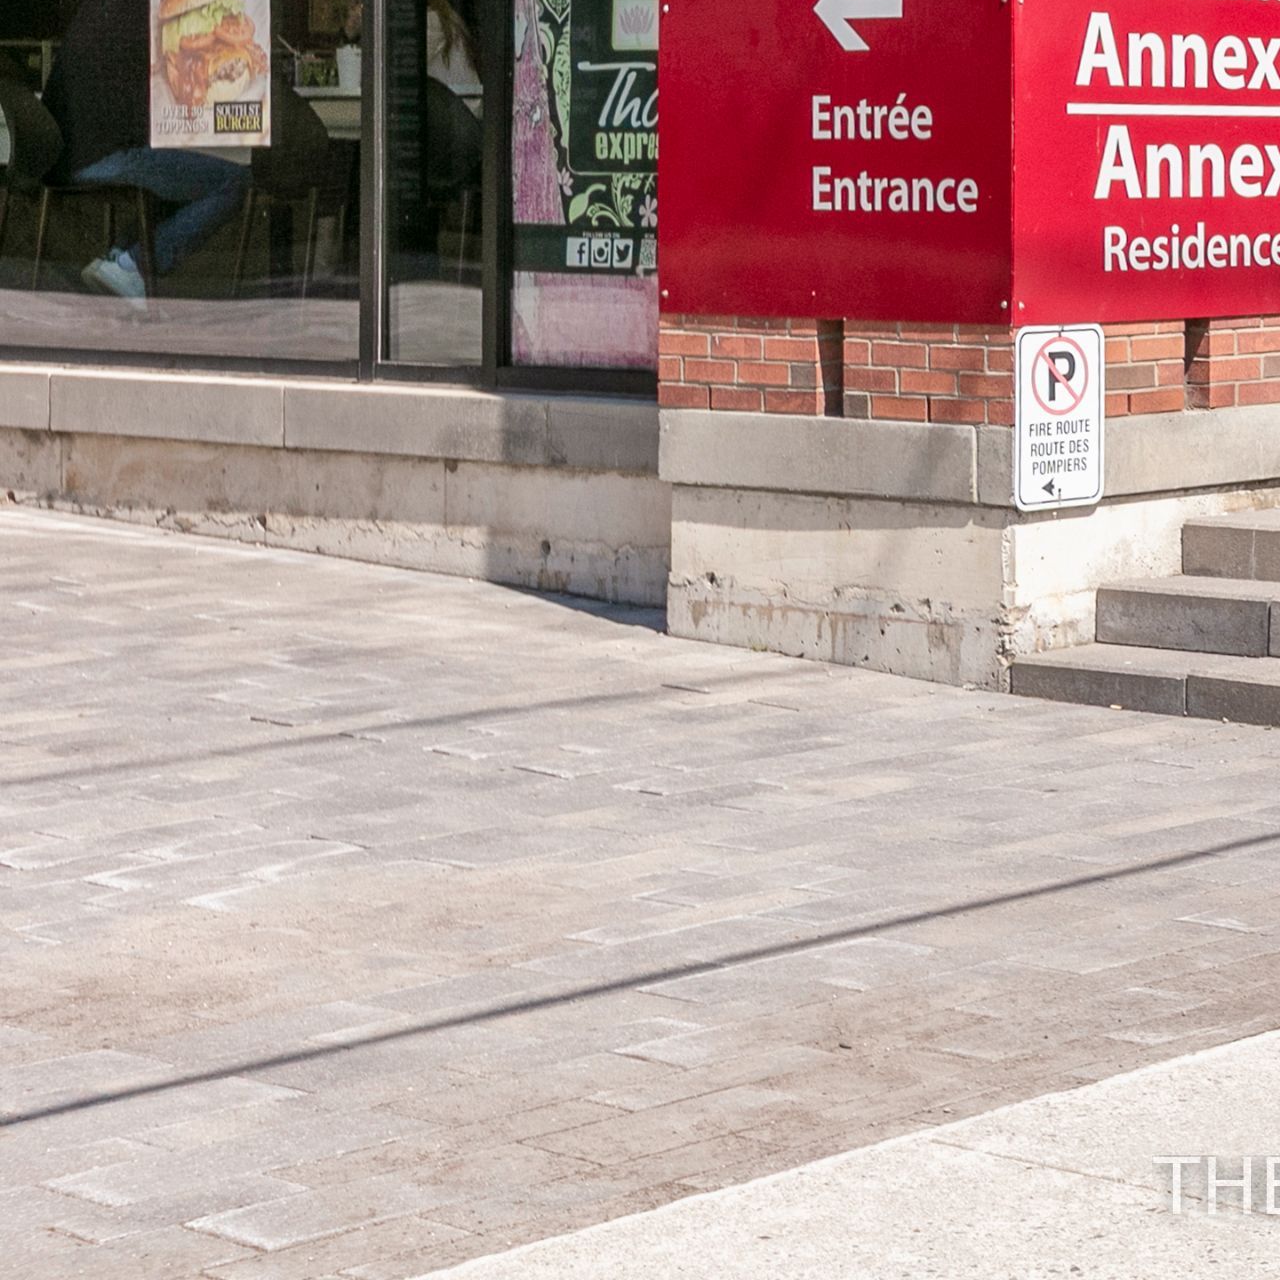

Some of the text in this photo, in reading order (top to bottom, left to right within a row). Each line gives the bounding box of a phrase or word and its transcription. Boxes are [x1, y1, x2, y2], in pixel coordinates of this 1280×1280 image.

[215, 103, 248, 117] SOUTH
[811, 92, 933, 141] Entrée
[216, 115, 261, 131] BURGER
[595, 131, 659, 165] expre
[812, 165, 979, 213] Entrance
[1029, 418, 1091, 438] FIRE ROUTE
[1030, 439, 1090, 458] ROUTE DES
[1032, 456, 1087, 476] POMPIERS
